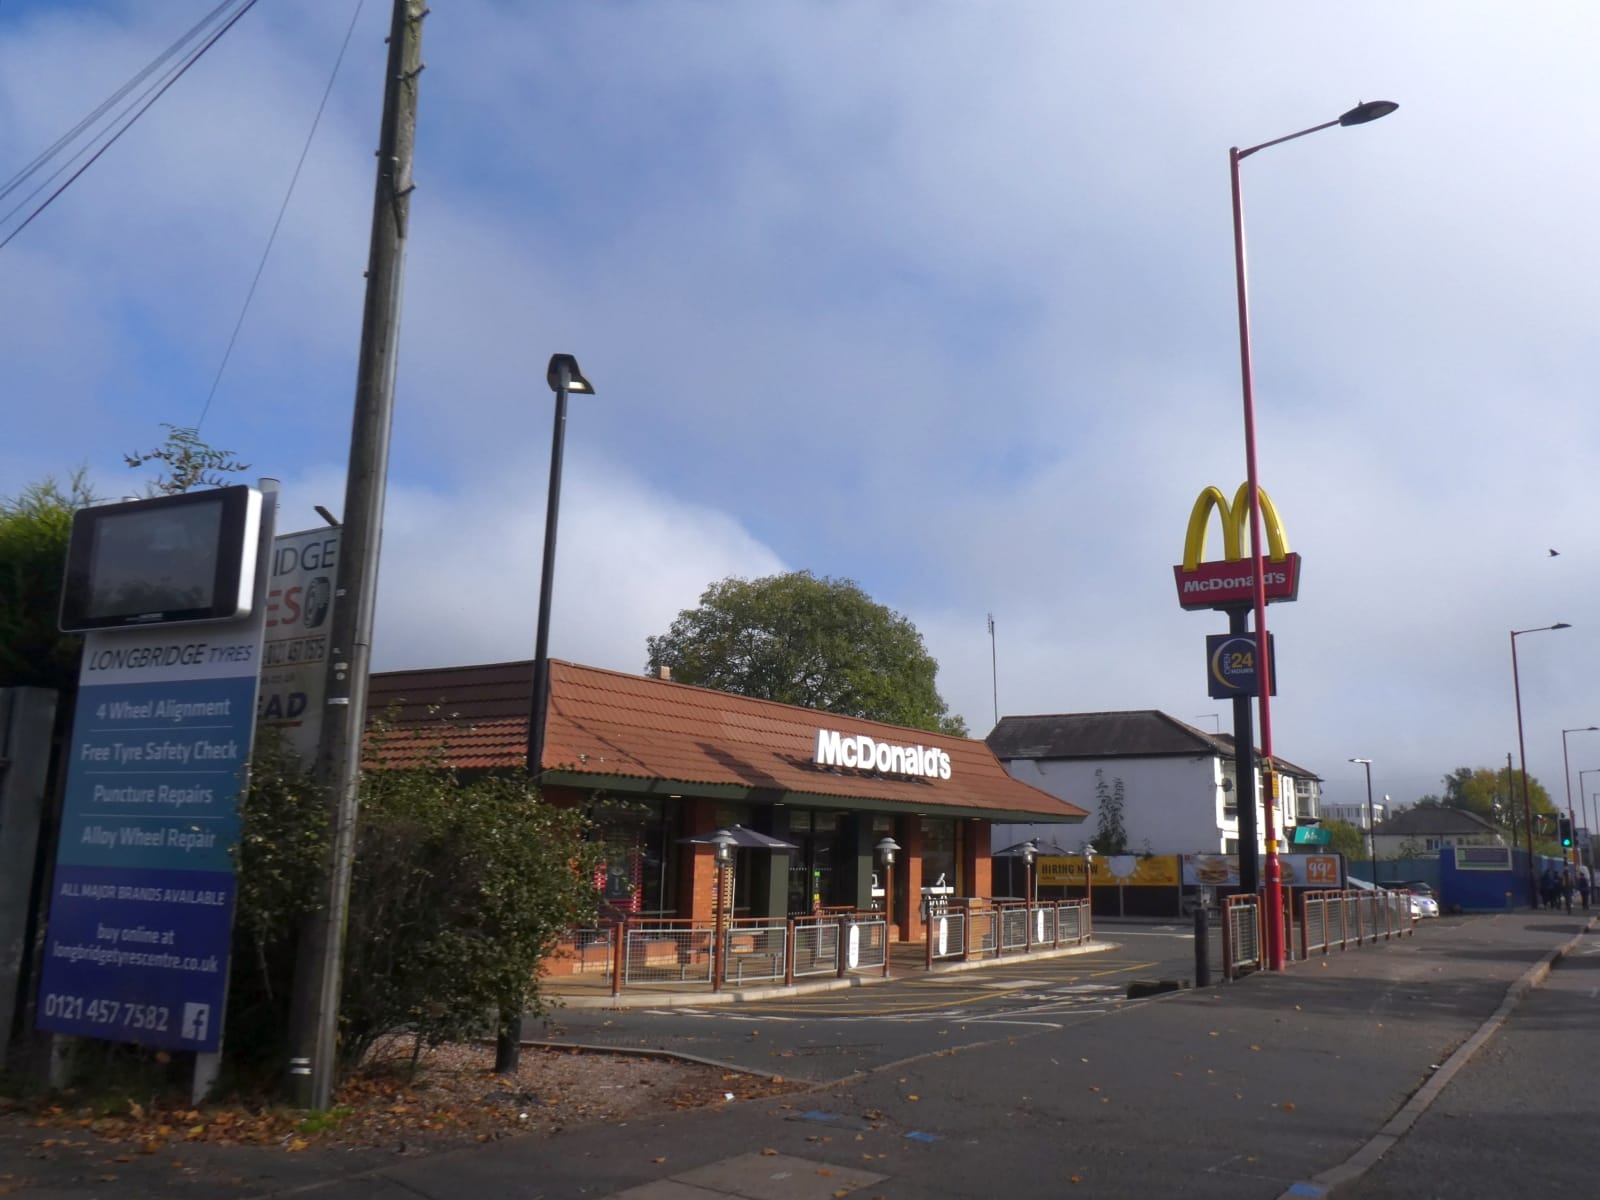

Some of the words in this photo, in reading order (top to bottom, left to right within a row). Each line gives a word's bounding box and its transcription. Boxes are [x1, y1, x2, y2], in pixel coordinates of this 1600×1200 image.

[1184, 572, 1286, 593] McDonad's
[88, 644, 208, 671] LONGBRIDGE
[207, 644, 253, 663] TYRES
[1231, 652, 1254, 668] 24
[96, 703, 106, 720] 4
[108, 701, 152, 719] Wheel
[154, 698, 231, 722] Alignment
[80, 743, 110, 761] Free
[113, 742, 142, 765] Tyre
[144, 741, 192, 764] Safety
[193, 739, 238, 760] Check
[816, 729, 952, 780] McDonald's
[93, 785, 155, 803] Puncture
[158, 783, 213, 808] Repairs
[81, 825, 117, 849] Alloy
[119, 827, 164, 847] Wheel
[167, 828, 215, 852] Repair
[1041, 863, 1074, 875] HIRING
[1077, 863, 1099, 875] NW
[60, 882, 80, 897] ALL
[80, 884, 117, 901] MAJOR
[117, 885, 163, 902] BRANDS
[163, 888, 226, 906] AVAILABLE
[96, 922, 119, 944] buy
[121, 925, 159, 944] online
[161, 929, 175, 945] at
[52, 940, 219, 973] longbridgetyrescentre.co.uk
[45, 993, 83, 1020] 0121
[86, 998, 120, 1024] 457
[122, 1003, 169, 1032] 7582
